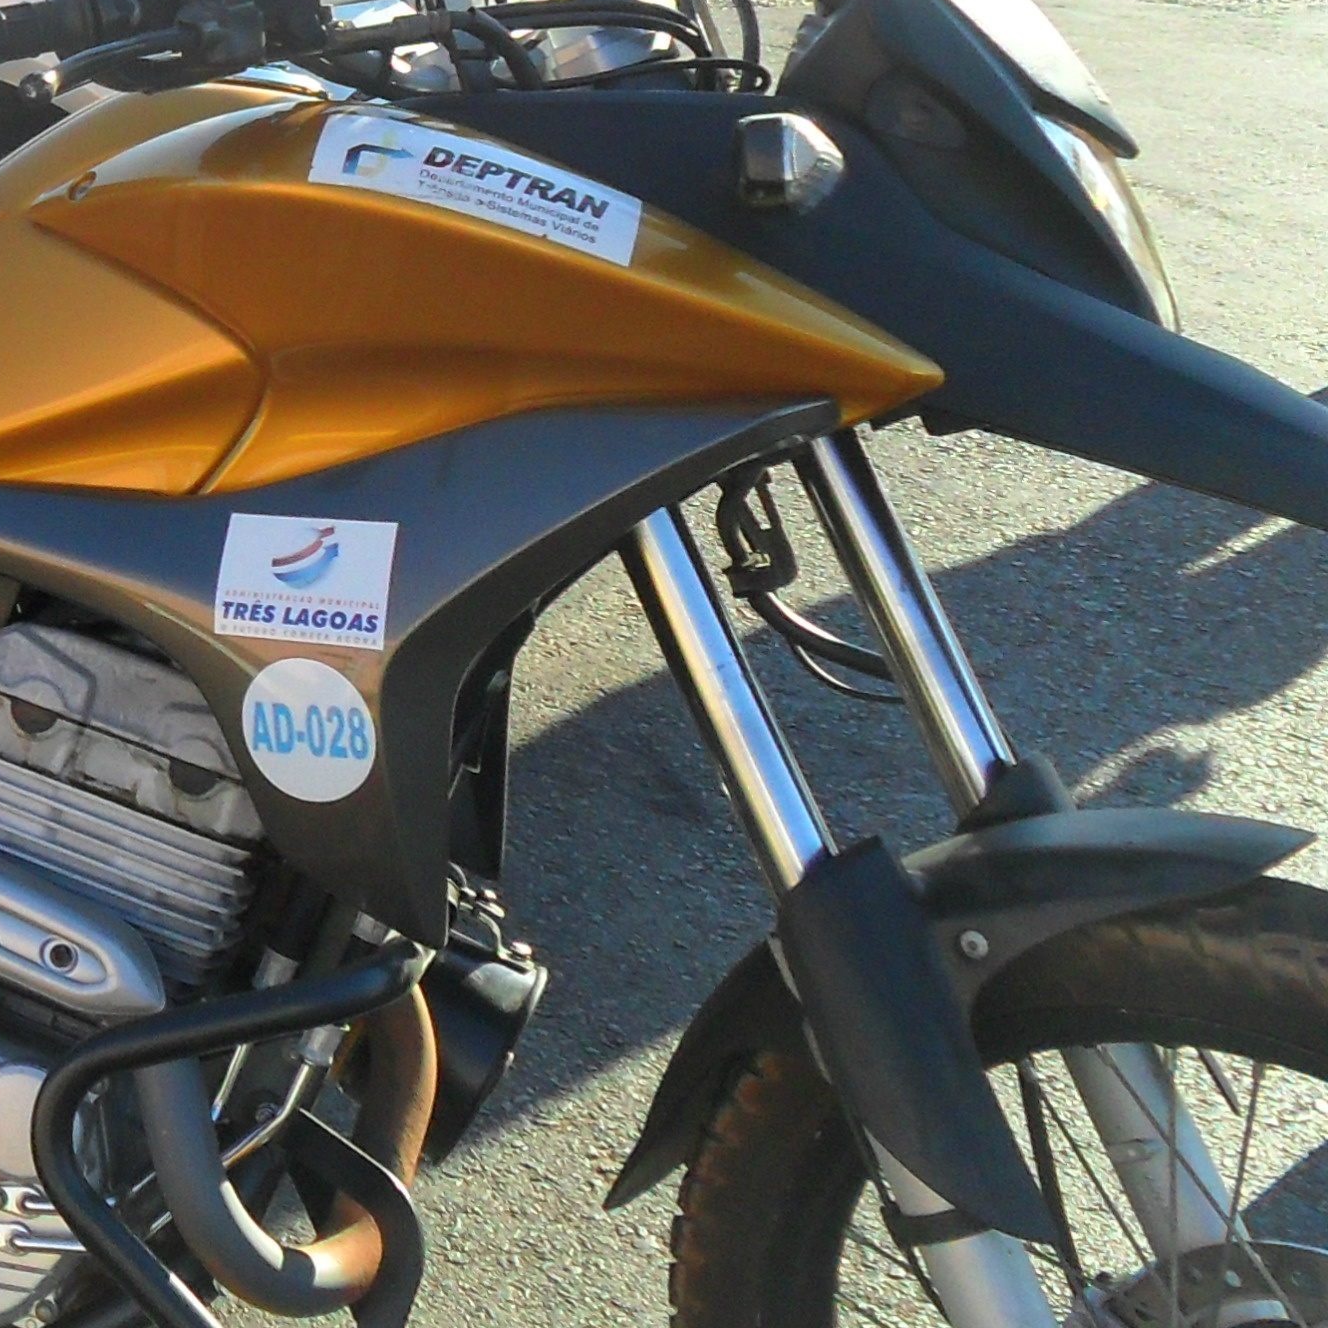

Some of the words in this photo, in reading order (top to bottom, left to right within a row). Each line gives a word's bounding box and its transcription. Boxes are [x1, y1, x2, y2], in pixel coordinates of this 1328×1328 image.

[423, 146, 610, 220] DEPTRAN
[486, 200, 548, 228] Sistemas
[552, 222, 597, 245] Viários
[517, 192, 580, 224] Municipal
[583, 220, 600, 232] de
[222, 600, 277, 624] TRÊS
[282, 607, 380, 633] LAGOAS
[318, 597, 380, 610] MUNICIPAL
[233, 625, 277, 637] FUTURO
[336, 634, 378, 647] AGORA
[251, 701, 370, 760] AD-028
